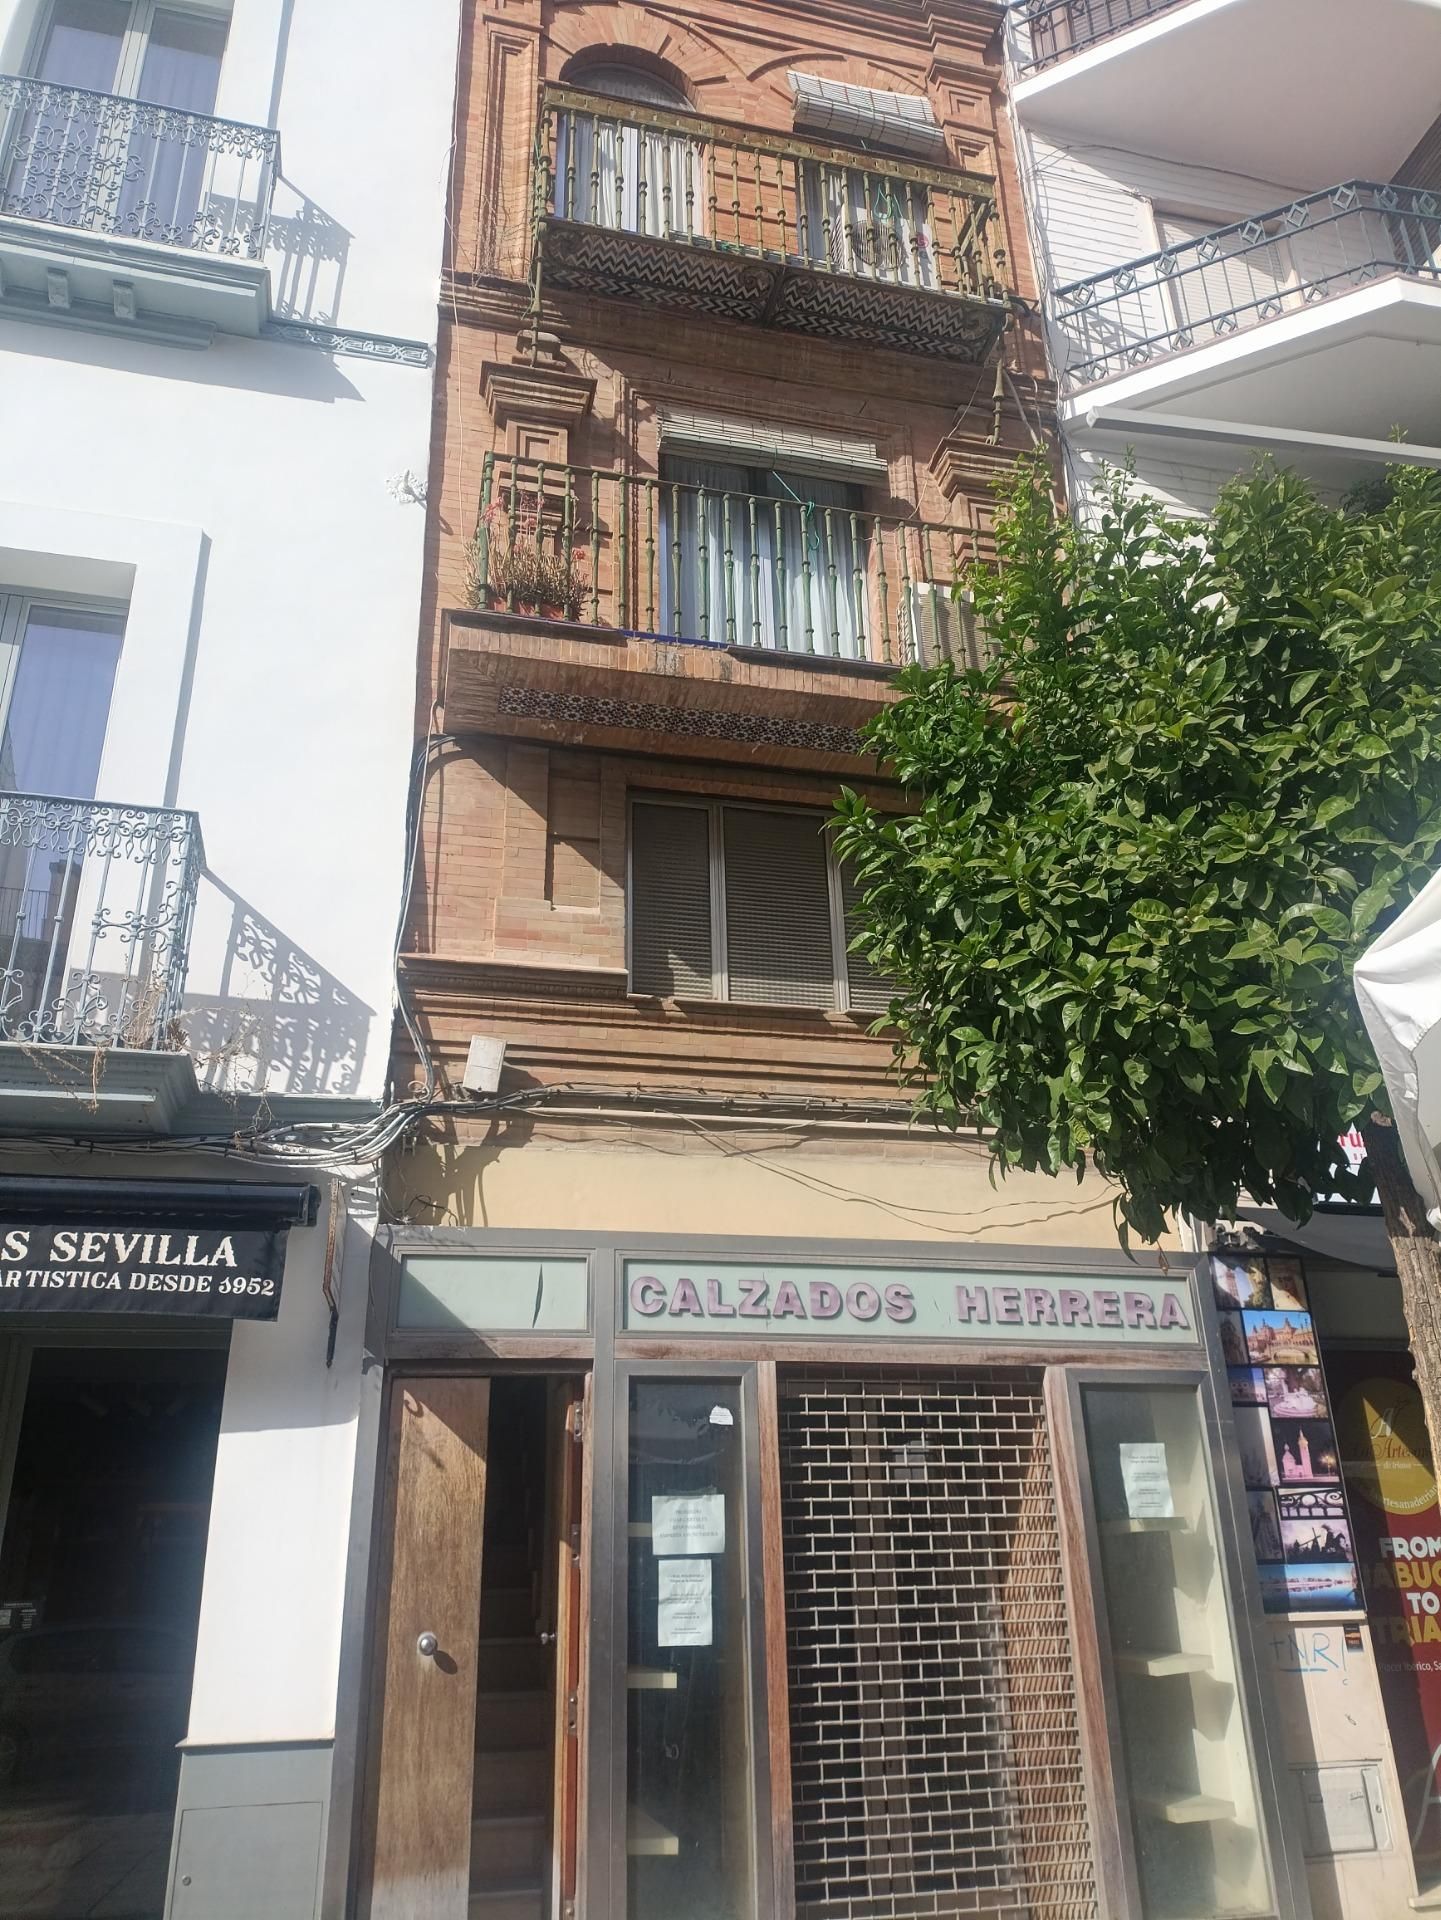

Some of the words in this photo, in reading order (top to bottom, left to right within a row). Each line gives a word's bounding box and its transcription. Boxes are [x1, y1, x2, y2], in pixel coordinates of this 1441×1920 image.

[50, 1232, 237, 1267] SEVILLA
[0, 1270, 121, 1289] RTISTICA
[129, 1272, 212, 1292] DESDE
[218, 1277, 274, 1296] 1952
[630, 1276, 917, 1323] CALZADOS
[955, 1285, 1190, 1330] HERRERA
[1406, 1591, 1440, 1615] TO
